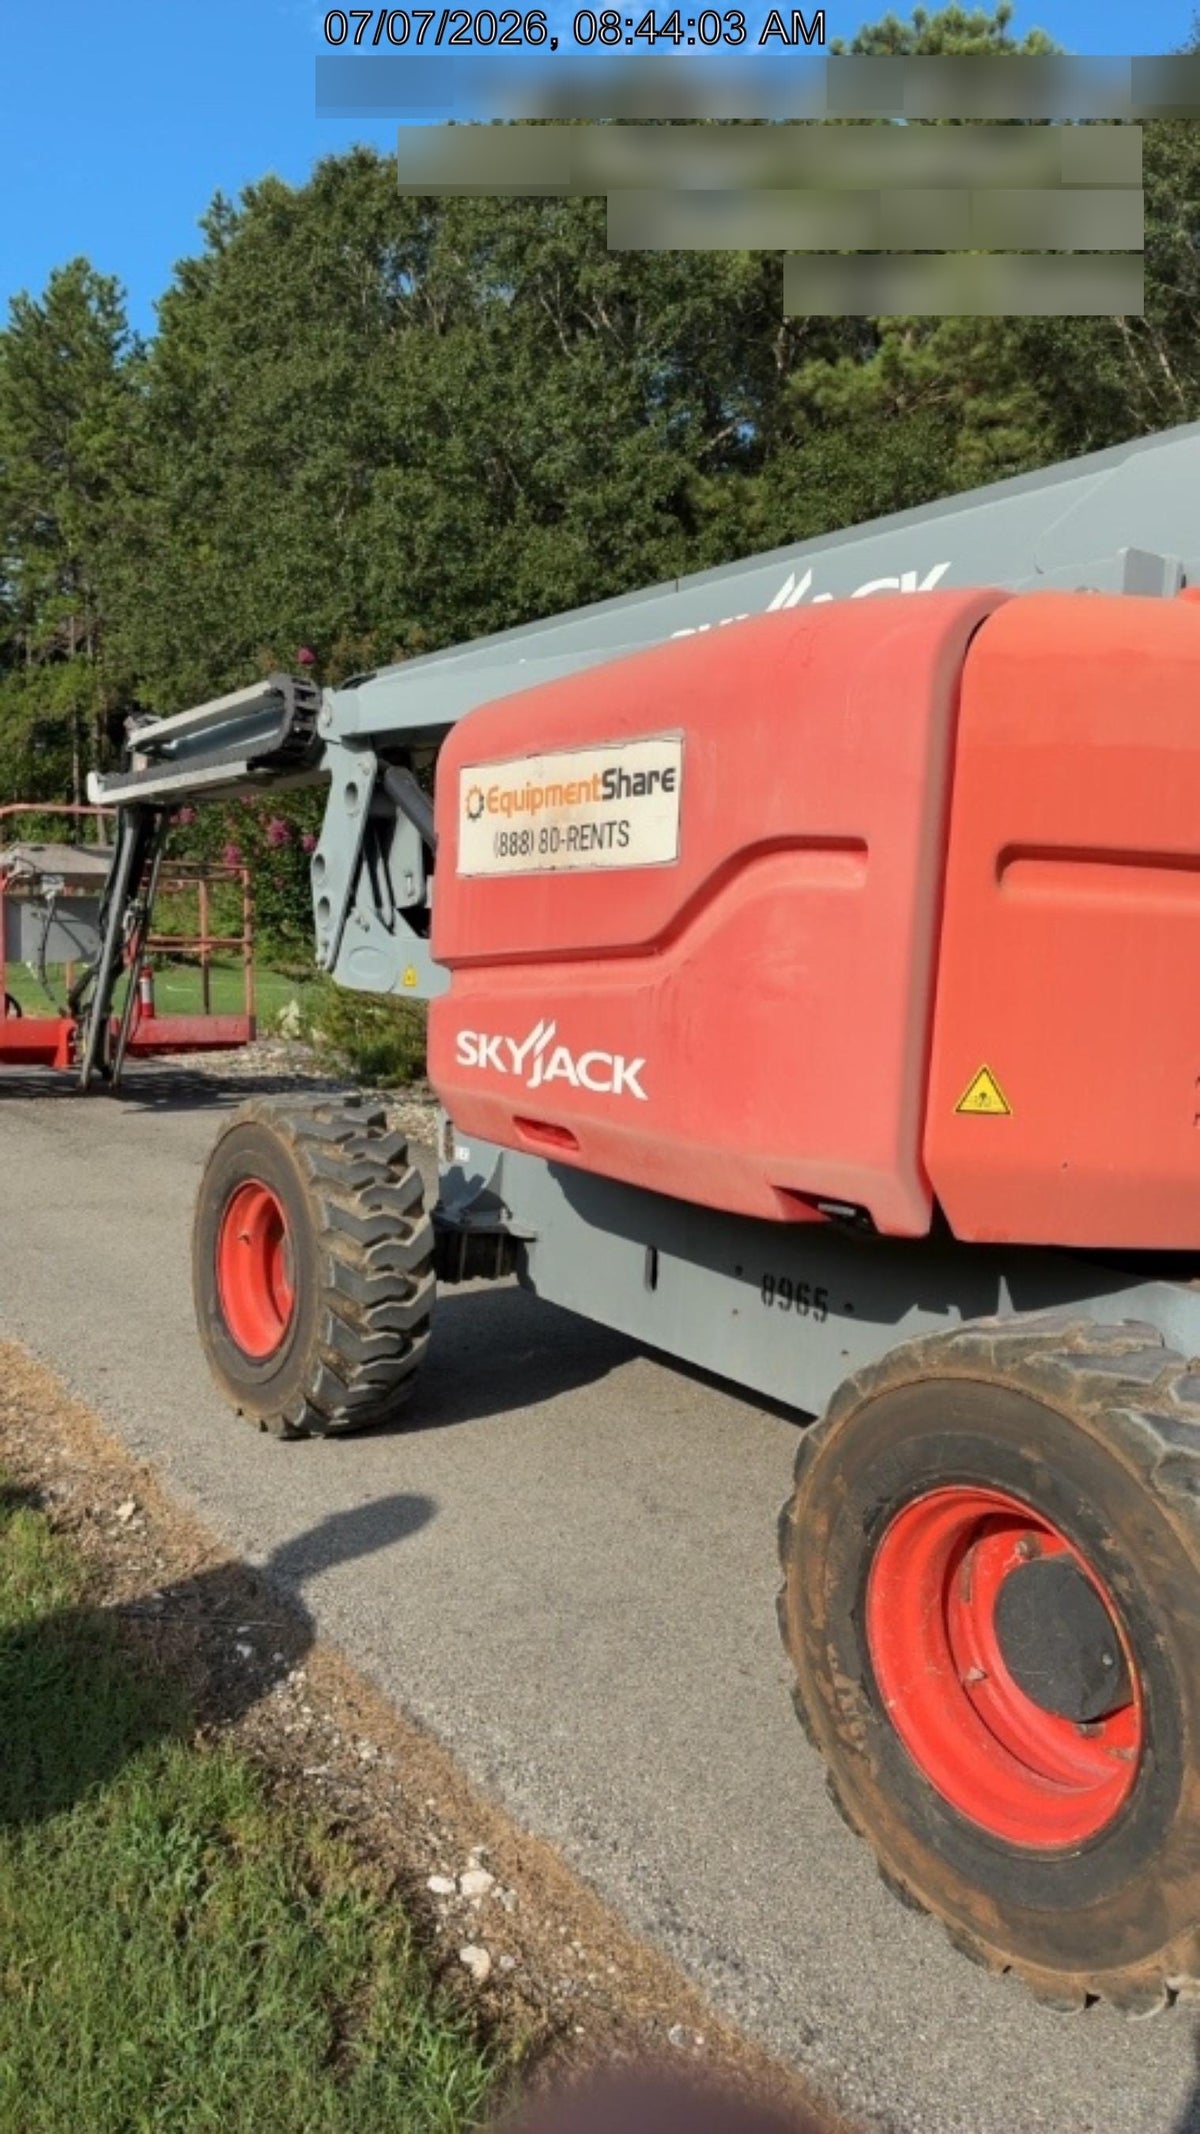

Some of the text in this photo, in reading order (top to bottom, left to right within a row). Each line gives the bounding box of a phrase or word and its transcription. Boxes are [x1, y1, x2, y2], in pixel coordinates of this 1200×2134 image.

[487, 767, 675, 817] EquipmentShare
[494, 820, 630, 858] (888) 80-RENTS
[455, 1018, 649, 1101] SKYJACK
[760, 1272, 829, 1323] 8965
